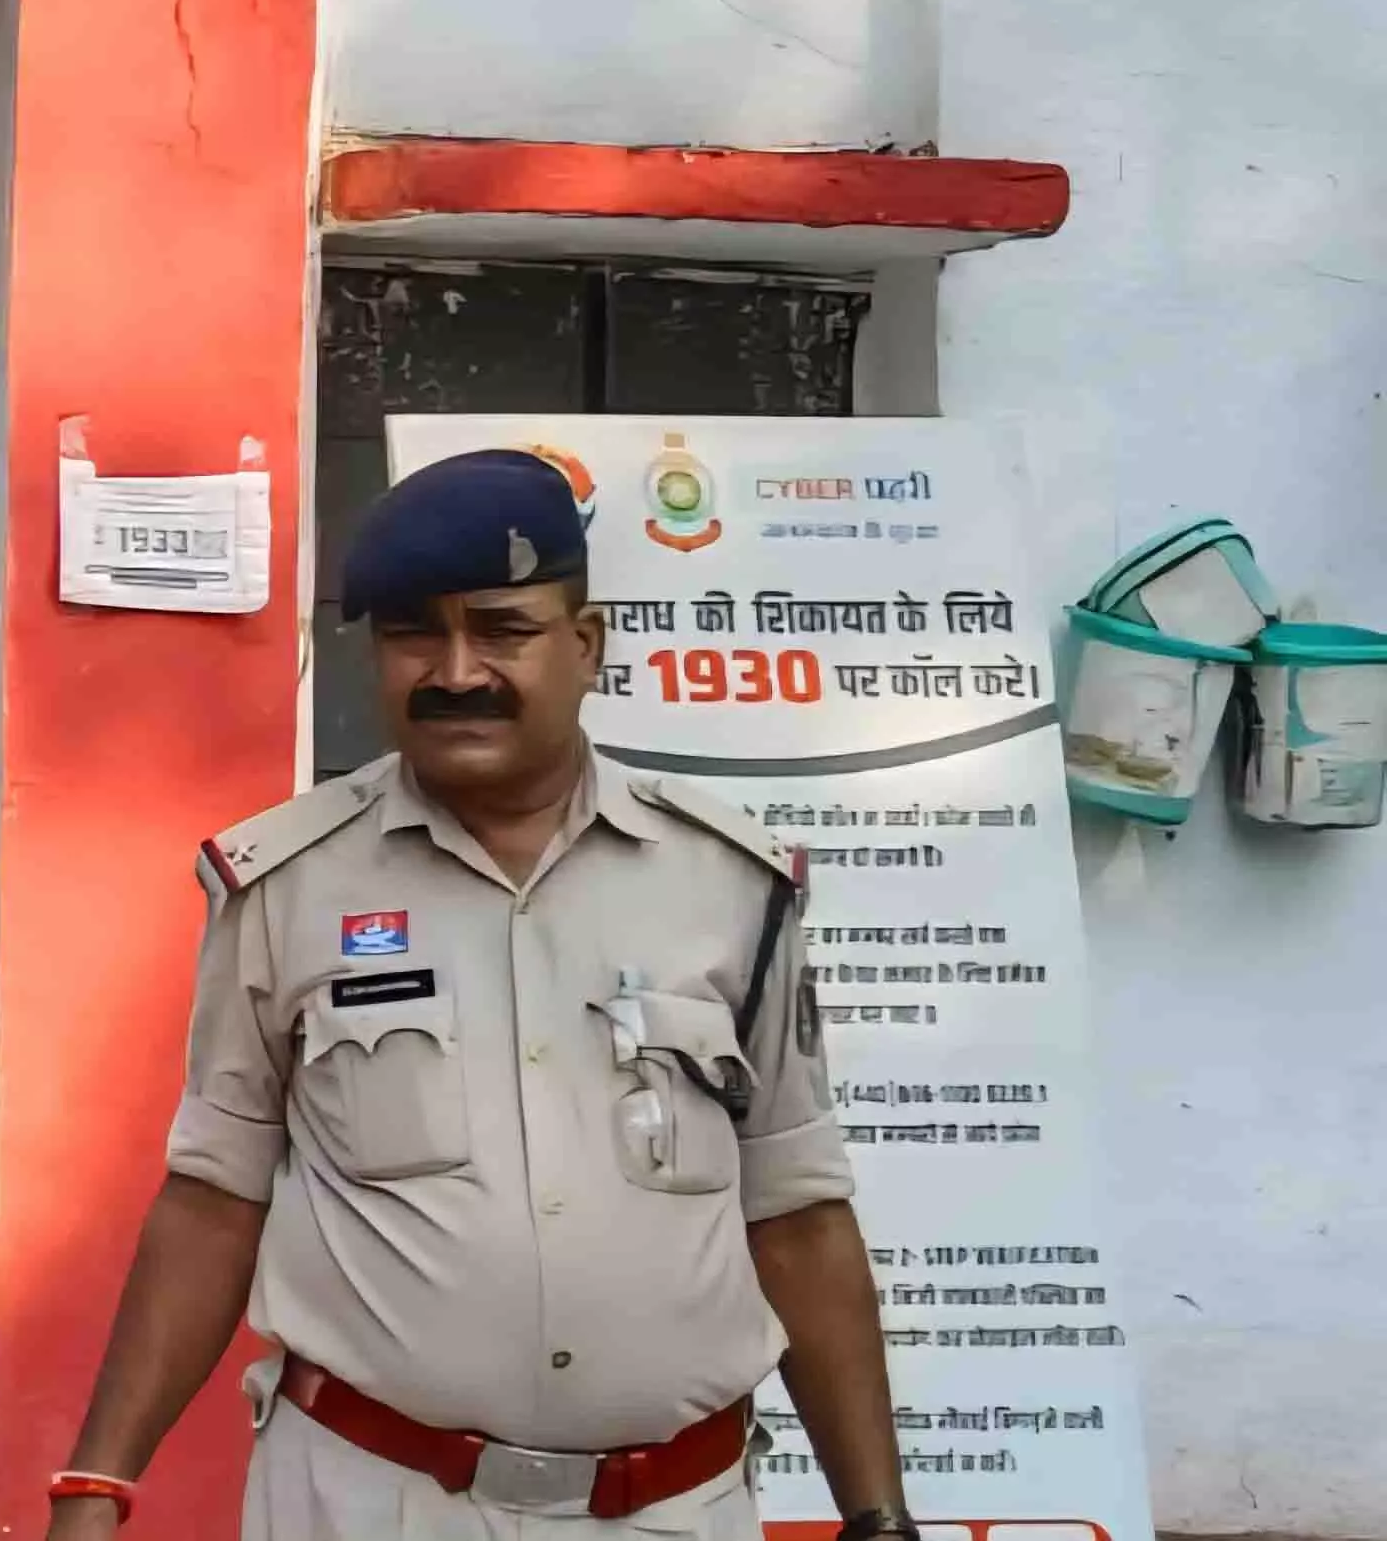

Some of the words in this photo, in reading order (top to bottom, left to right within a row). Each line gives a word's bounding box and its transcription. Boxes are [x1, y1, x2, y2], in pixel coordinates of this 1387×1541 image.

[689, 591, 736, 634] की
[751, 590, 887, 635] शिकायत
[892, 590, 930, 634] के
[942, 590, 1015, 635] लिये
[647, 648, 823, 704] 1930
[833, 664, 881, 699] पर
[884, 653, 963, 699] कॉल
